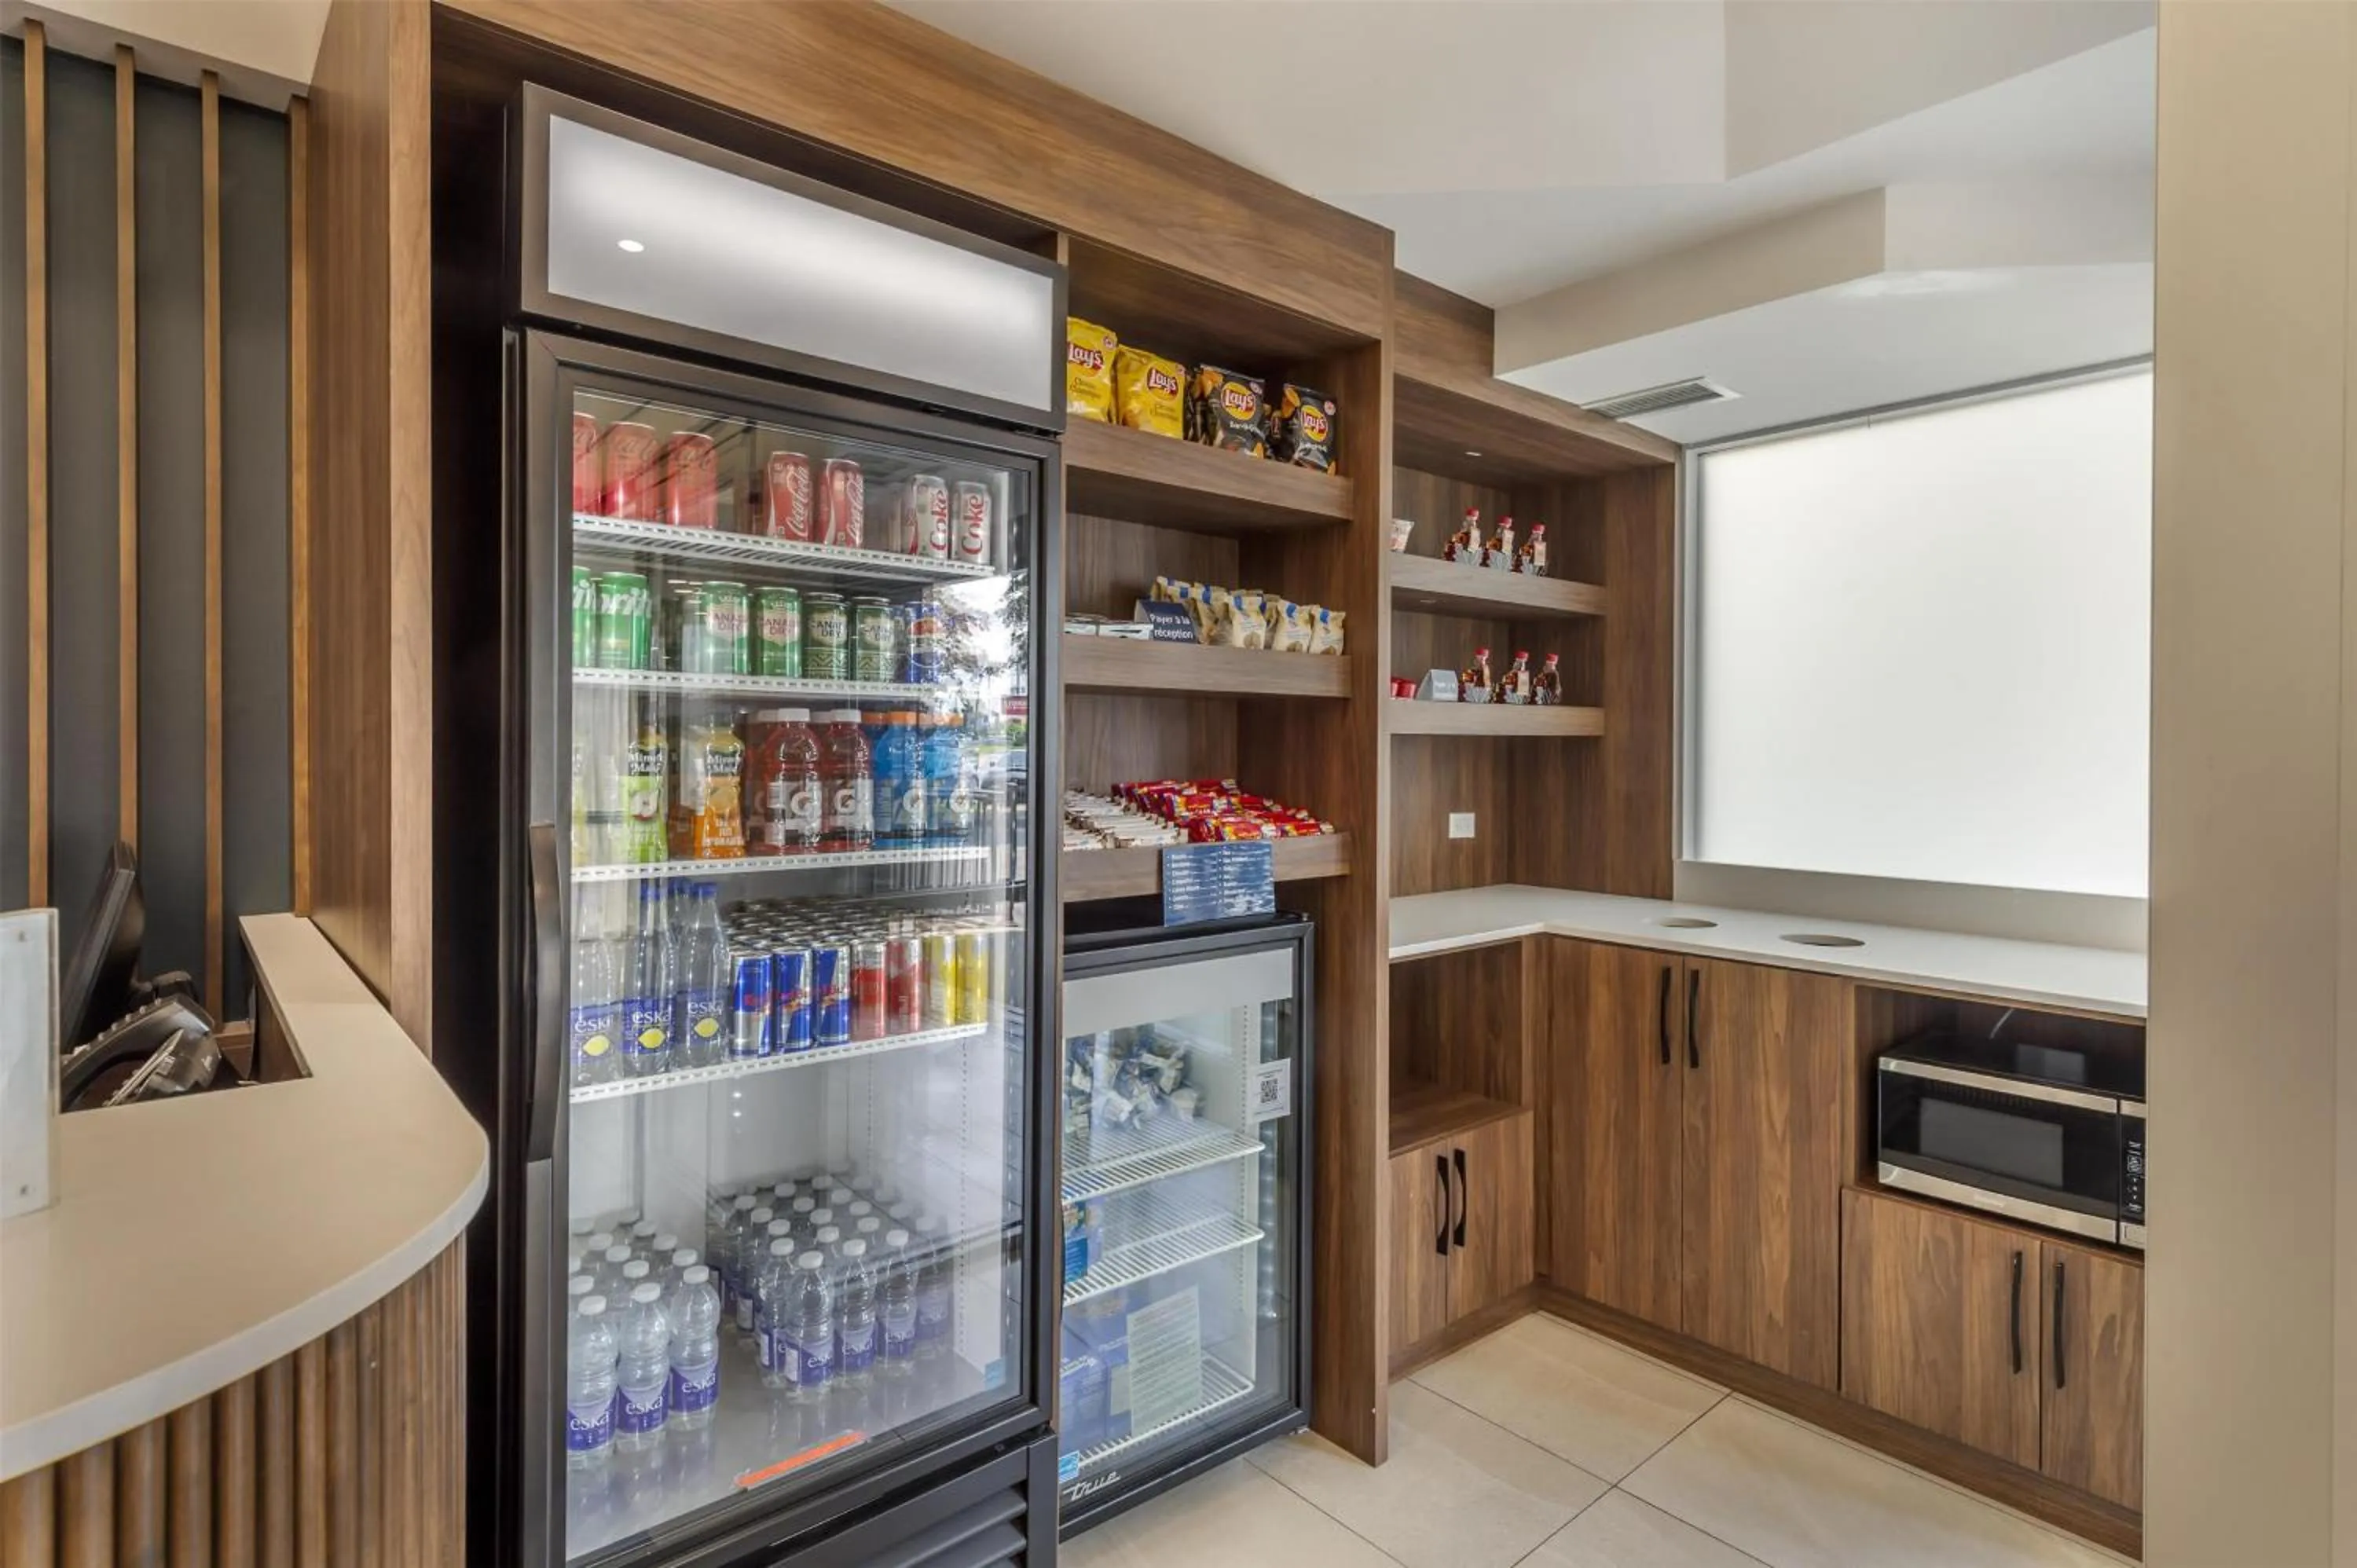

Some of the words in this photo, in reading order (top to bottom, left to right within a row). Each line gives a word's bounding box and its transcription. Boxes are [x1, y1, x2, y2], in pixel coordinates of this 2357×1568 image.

[1149, 368, 1177, 393] Lay's
[1225, 389, 1255, 412] Lay's
[961, 495, 984, 555] Coke
[1154, 627, 1193, 640] réception
